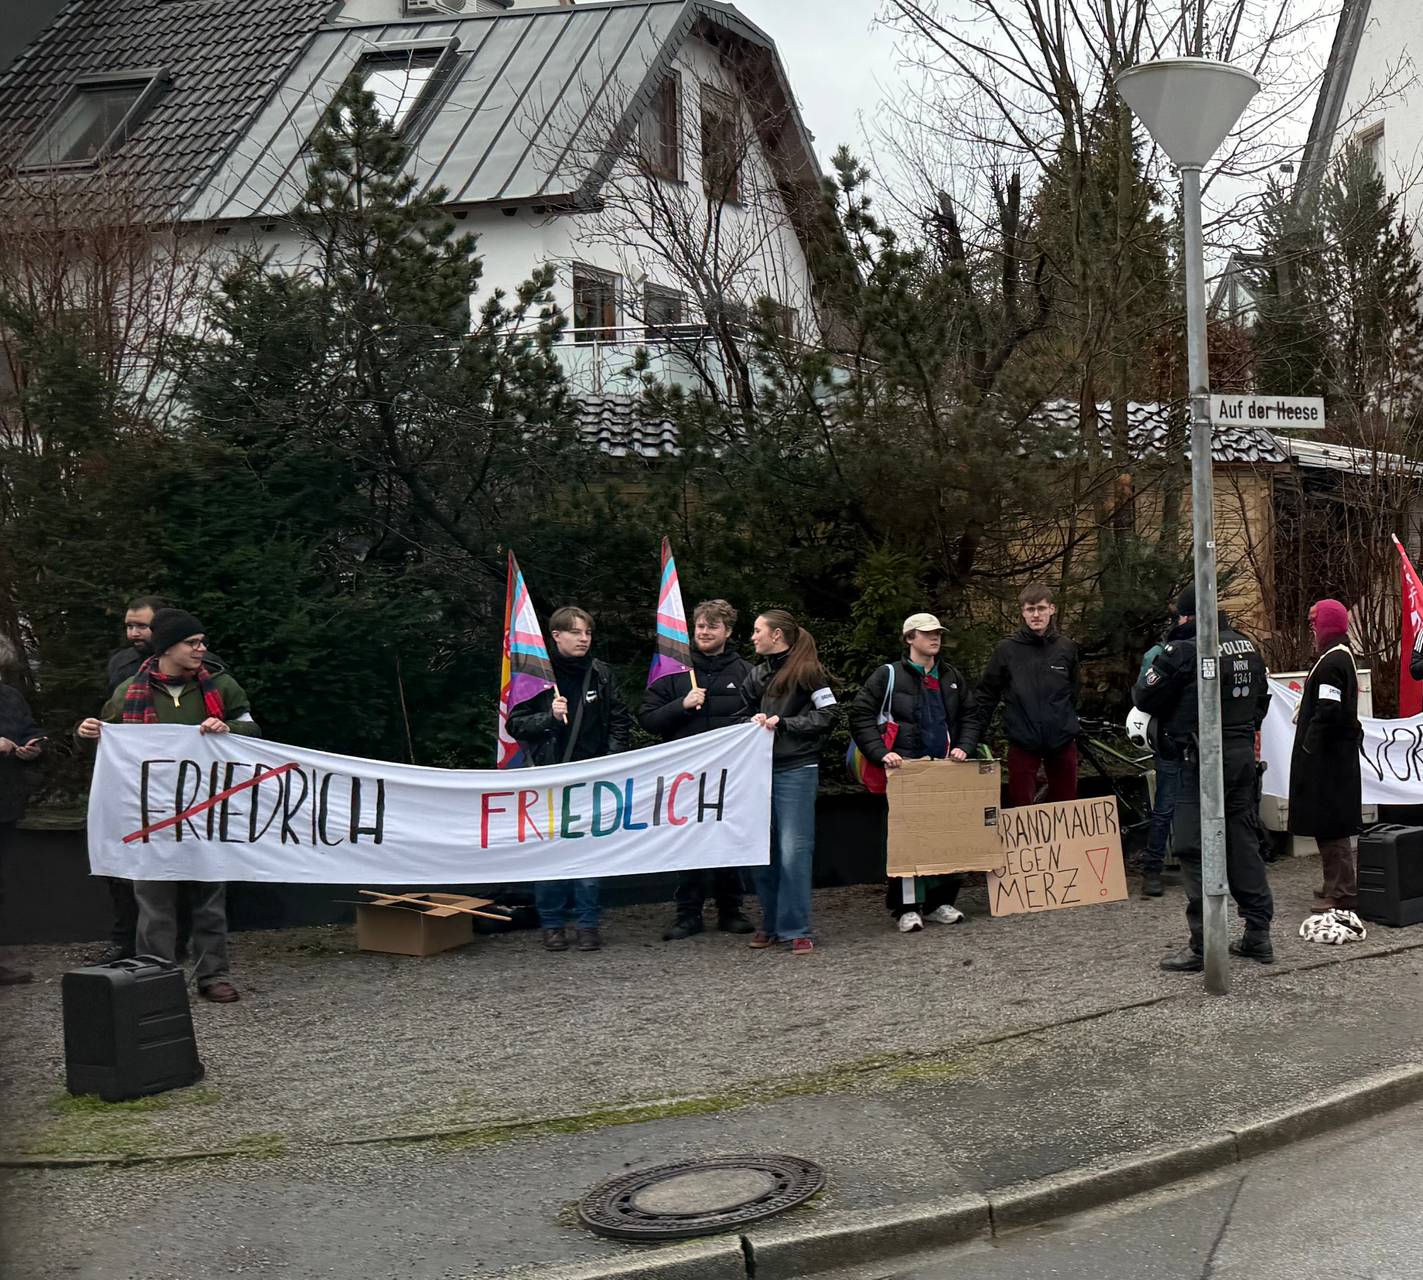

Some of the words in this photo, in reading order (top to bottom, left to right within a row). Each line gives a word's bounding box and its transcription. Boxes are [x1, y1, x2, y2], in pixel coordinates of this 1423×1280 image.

[1219, 400, 1243, 419] Auf
[1248, 401, 1271, 420] der
[1276, 401, 1319, 421] Heese
[1217, 640, 1256, 657] POLIZEI
[1233, 660, 1249, 671] NRW
[1233, 672, 1252, 685] 1341
[140, 759, 386, 848] FRIEDRICH
[480, 768, 728, 849] FRIEDLICH
[996, 867, 1081, 913] MERZ
